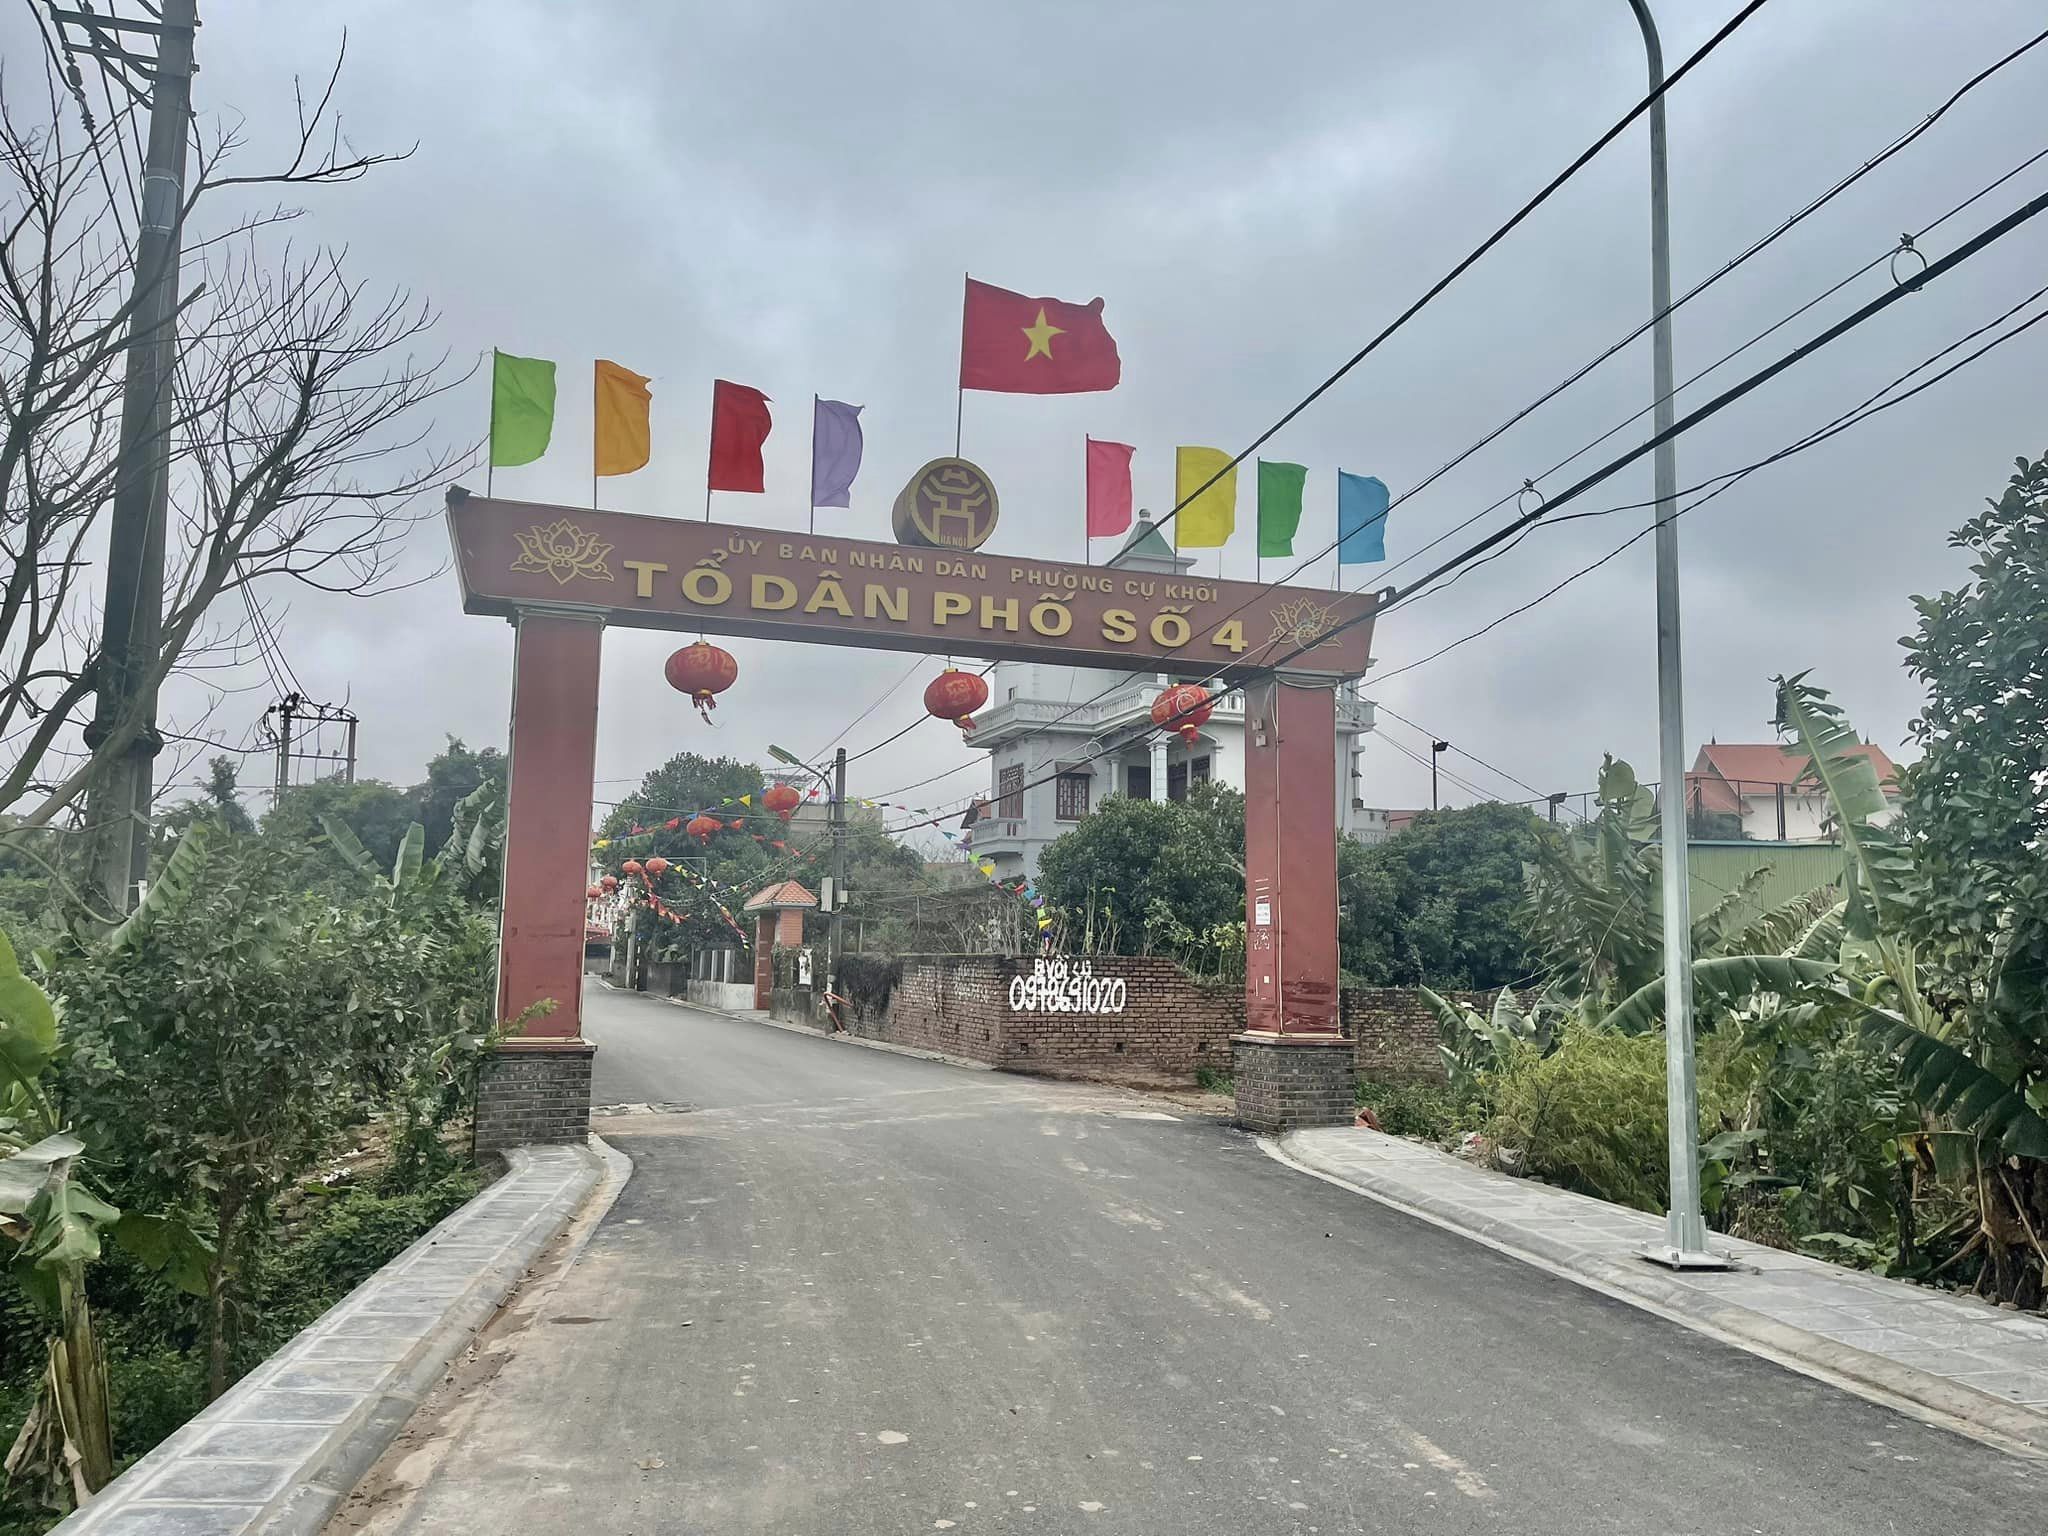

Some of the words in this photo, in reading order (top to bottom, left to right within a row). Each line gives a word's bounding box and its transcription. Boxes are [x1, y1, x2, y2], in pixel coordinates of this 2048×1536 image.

[623, 549, 733, 606] TỔ
[750, 569, 909, 621] DÂN
[933, 590, 1076, 637] PHỐ
[1101, 604, 1193, 648] SỐ
[1211, 619, 1249, 653] 4
[728, 531, 762, 555] ỦY
[779, 543, 837, 564] BAN
[850, 551, 923, 573] NHÂN
[935, 558, 986, 580] DÂN
[1010, 567, 1113, 593] PHƯỜNG
[1124, 580, 1155, 602] CỰ
[1165, 581, 1217, 603] KHỐI
